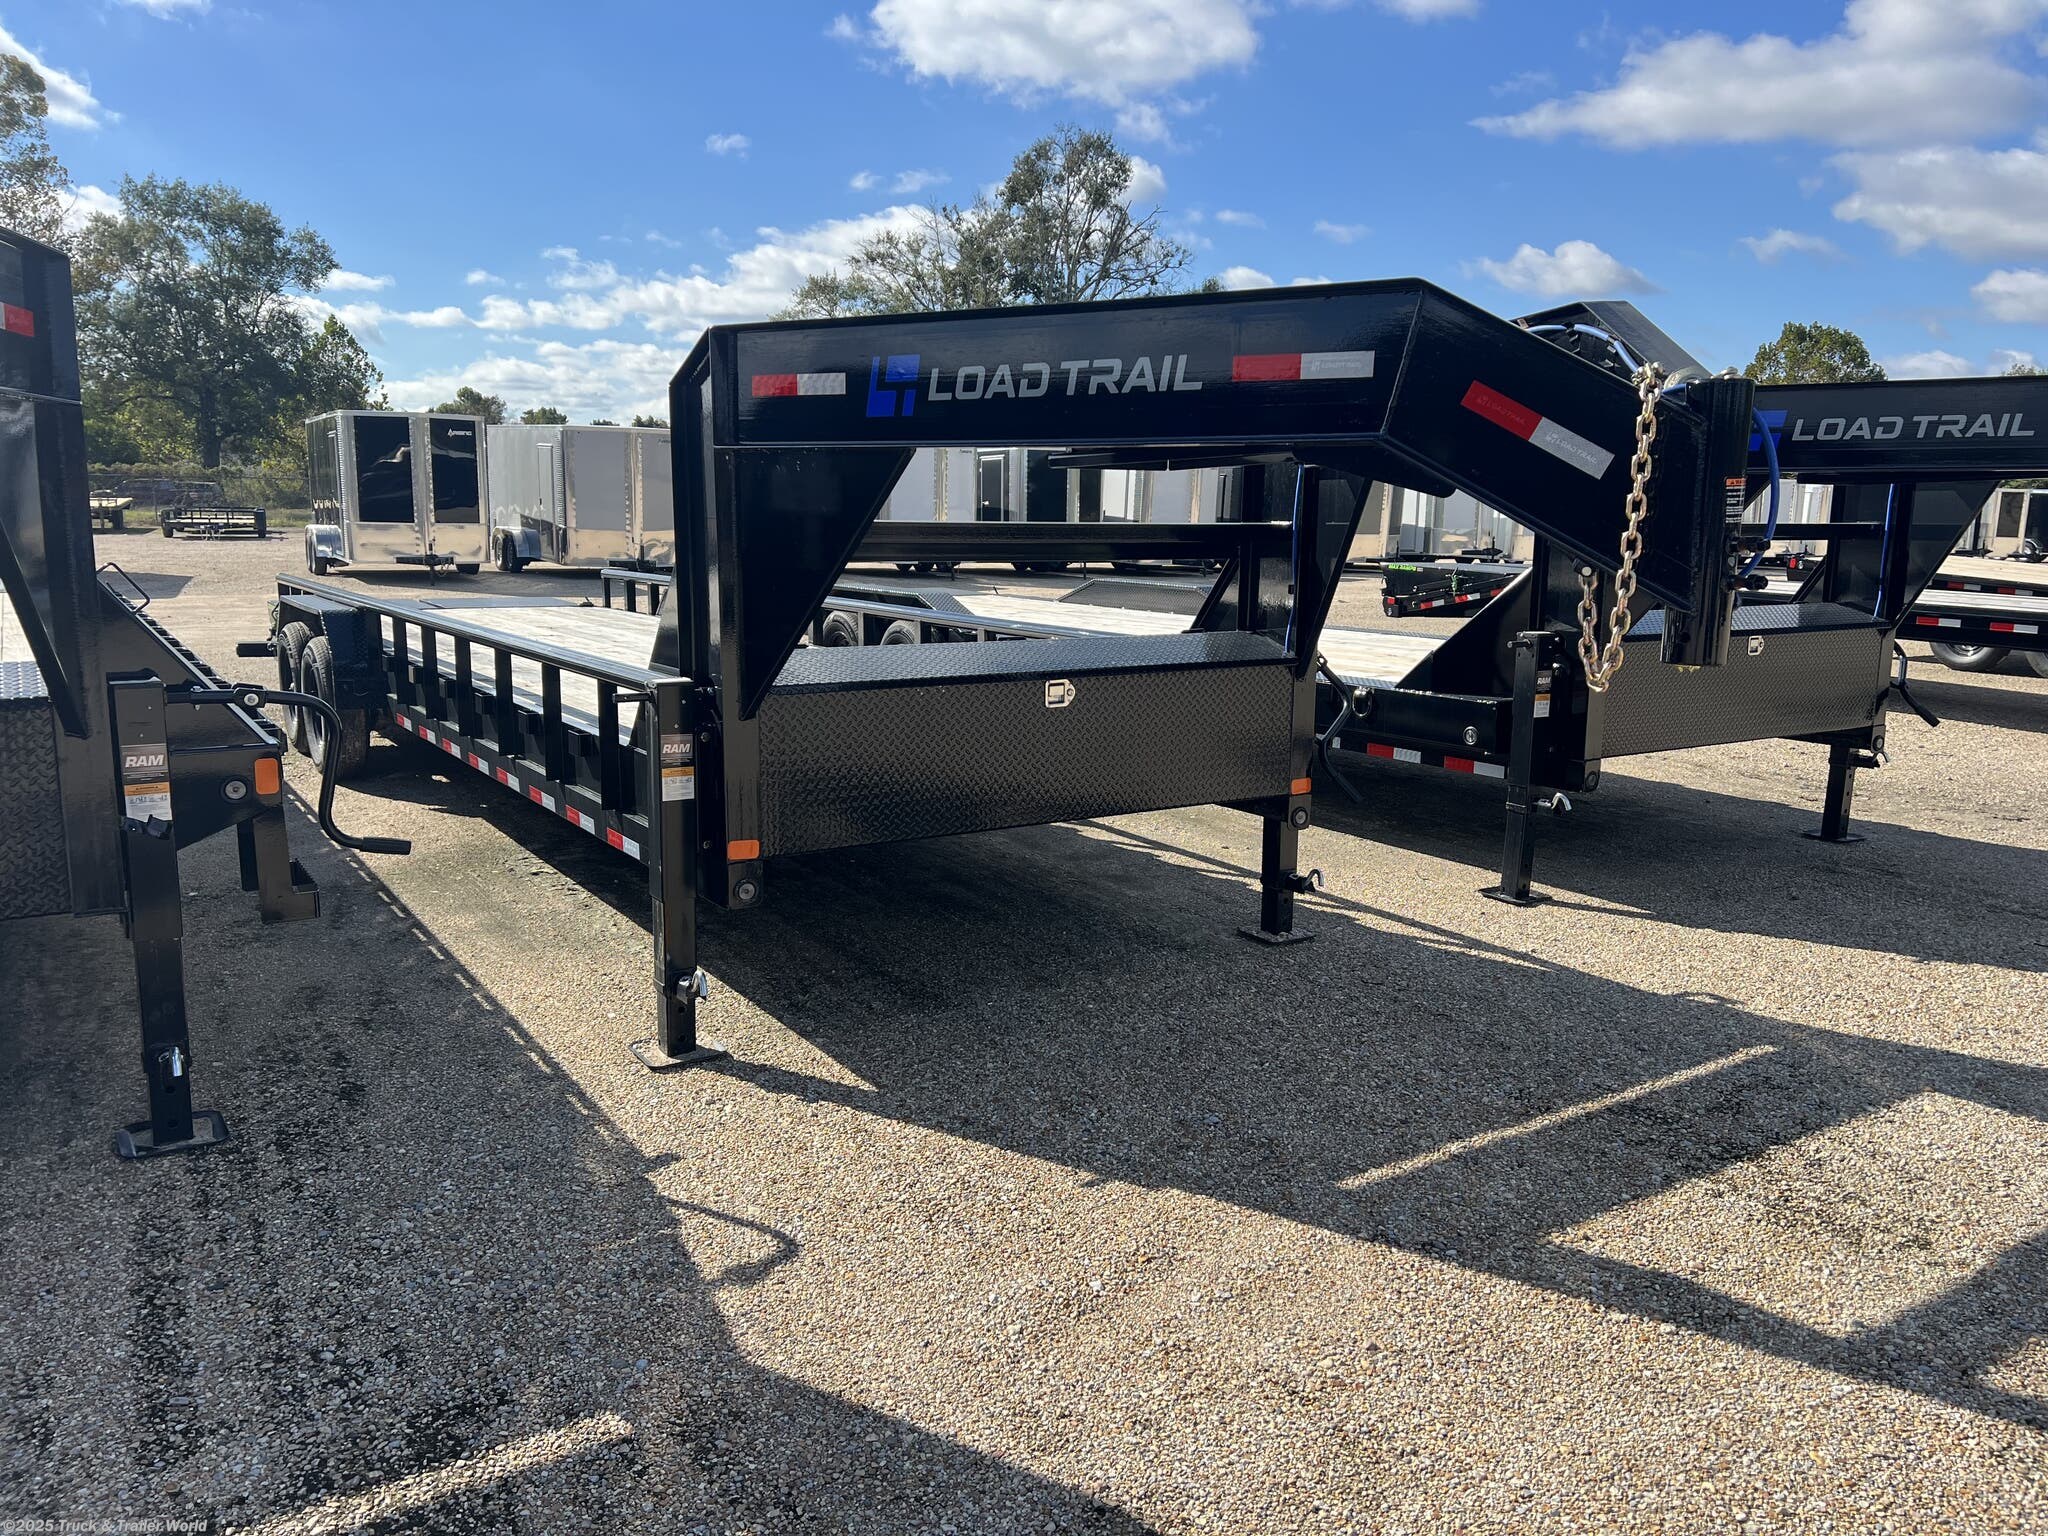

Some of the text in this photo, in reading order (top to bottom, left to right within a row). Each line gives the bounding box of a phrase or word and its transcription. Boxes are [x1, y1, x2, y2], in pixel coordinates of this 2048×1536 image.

[928, 354, 1203, 401] LOAD TRAIL
[1792, 413, 2035, 441] LOAD TRAIL
[662, 743, 691, 754] RAM
[125, 755, 164, 768] RAM
